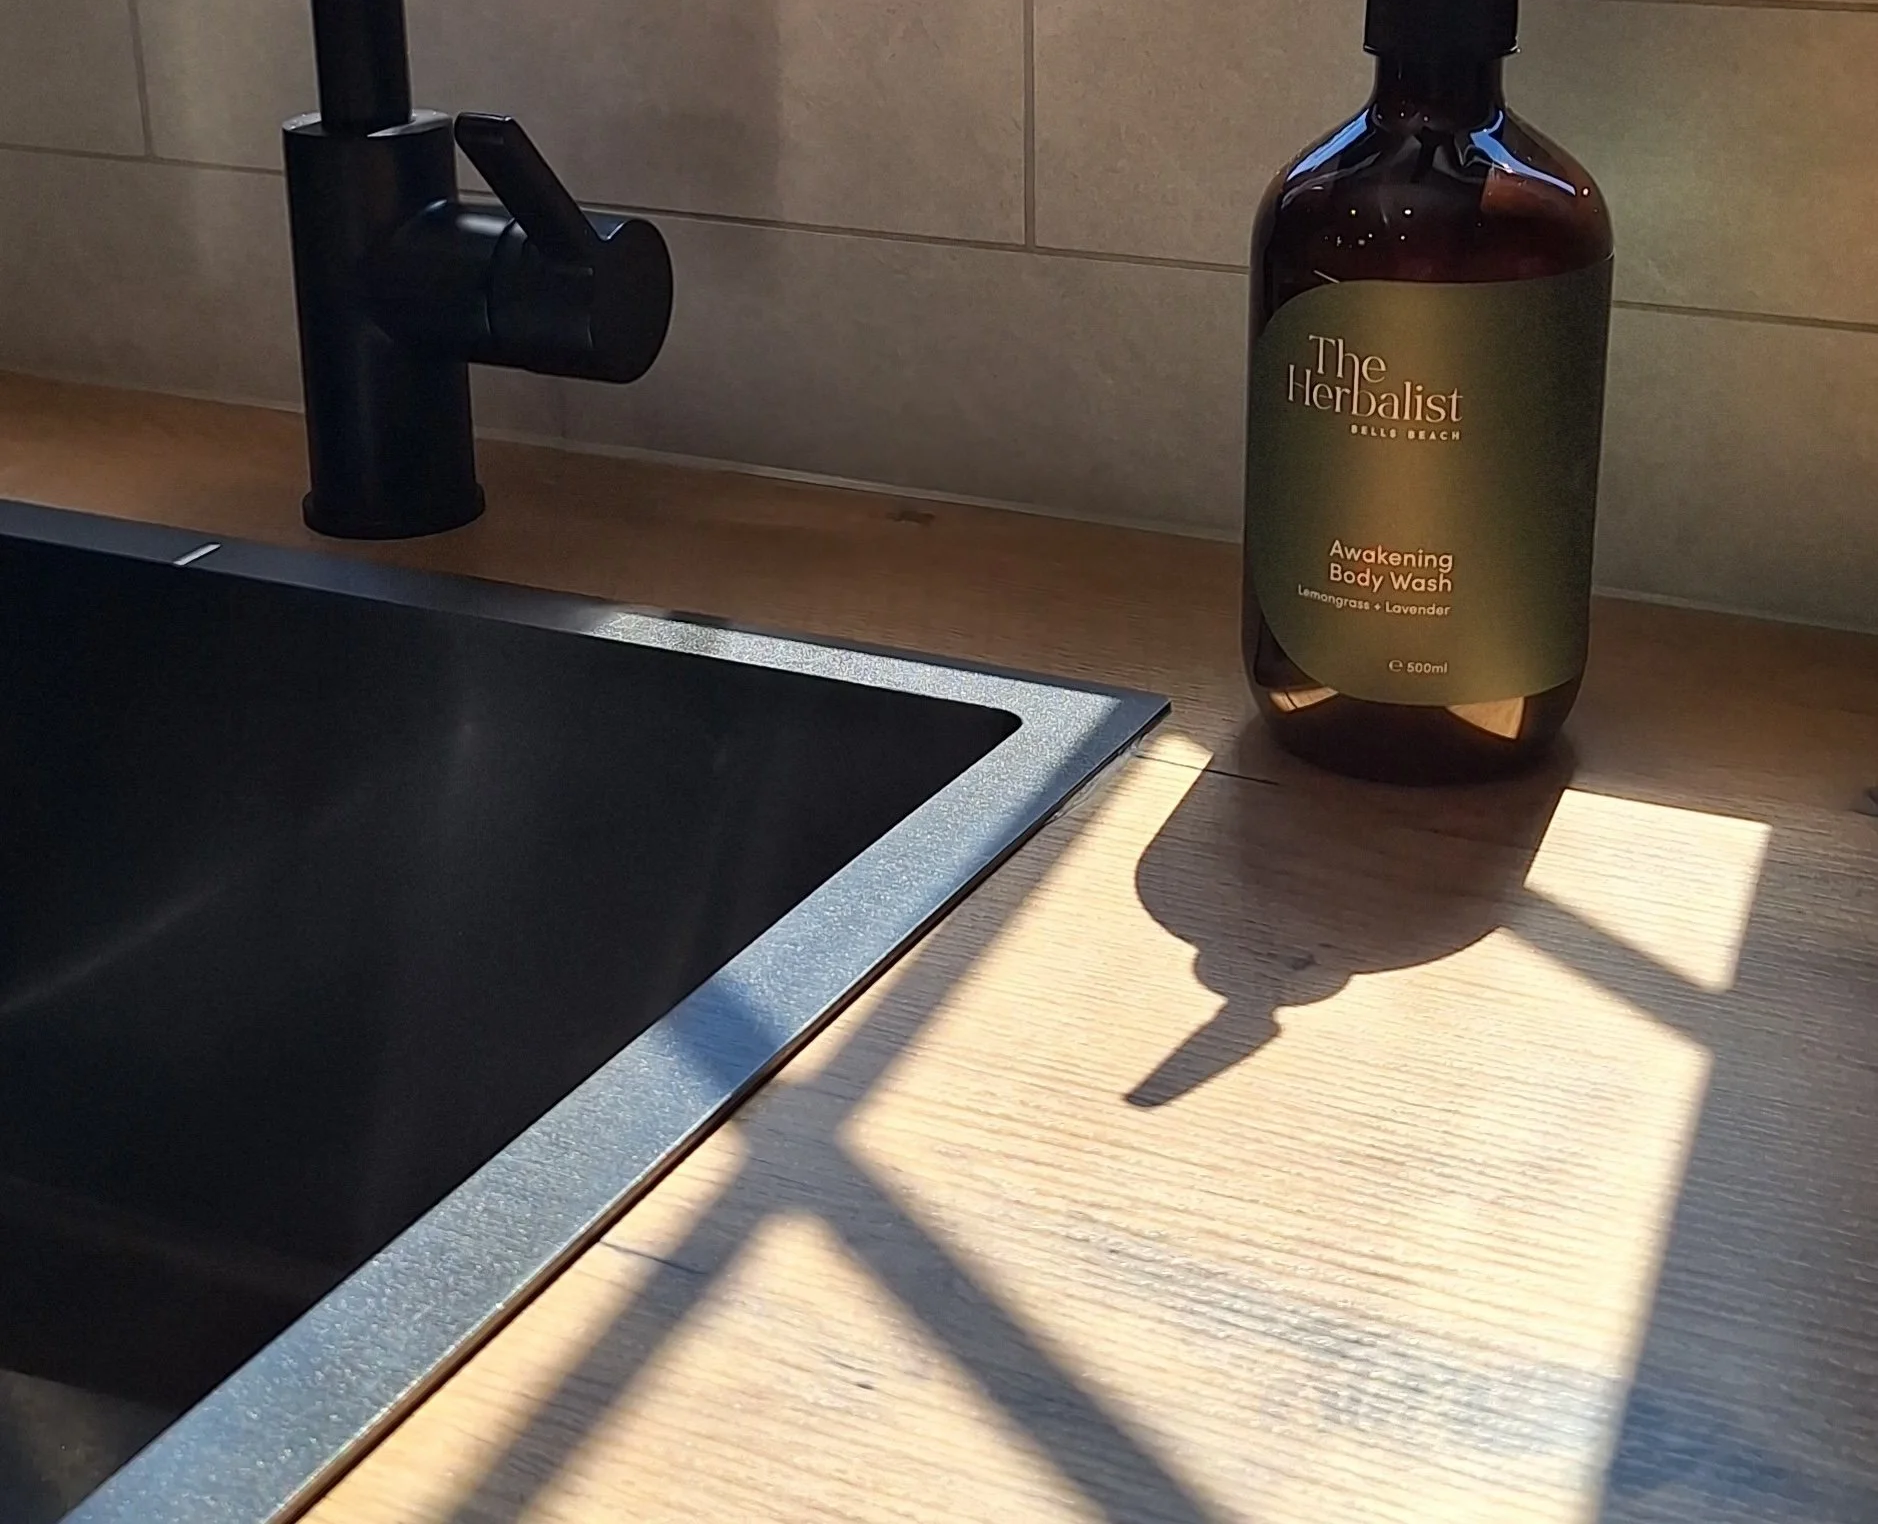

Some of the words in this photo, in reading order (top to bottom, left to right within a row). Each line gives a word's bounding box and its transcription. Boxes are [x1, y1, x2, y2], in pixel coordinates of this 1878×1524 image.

[1308, 334, 1387, 384] The
[1287, 364, 1464, 423] Herbalist
[1350, 424, 1397, 438] BELLS
[1407, 429, 1461, 441] BEACH
[1329, 539, 1453, 573] Awakening
[1329, 563, 1384, 592] Body
[1390, 572, 1452, 593] Wash
[1297, 584, 1371, 612] Lemongrass
[1385, 600, 1451, 617] Lavender
[1406, 660, 1449, 675] 500ml
